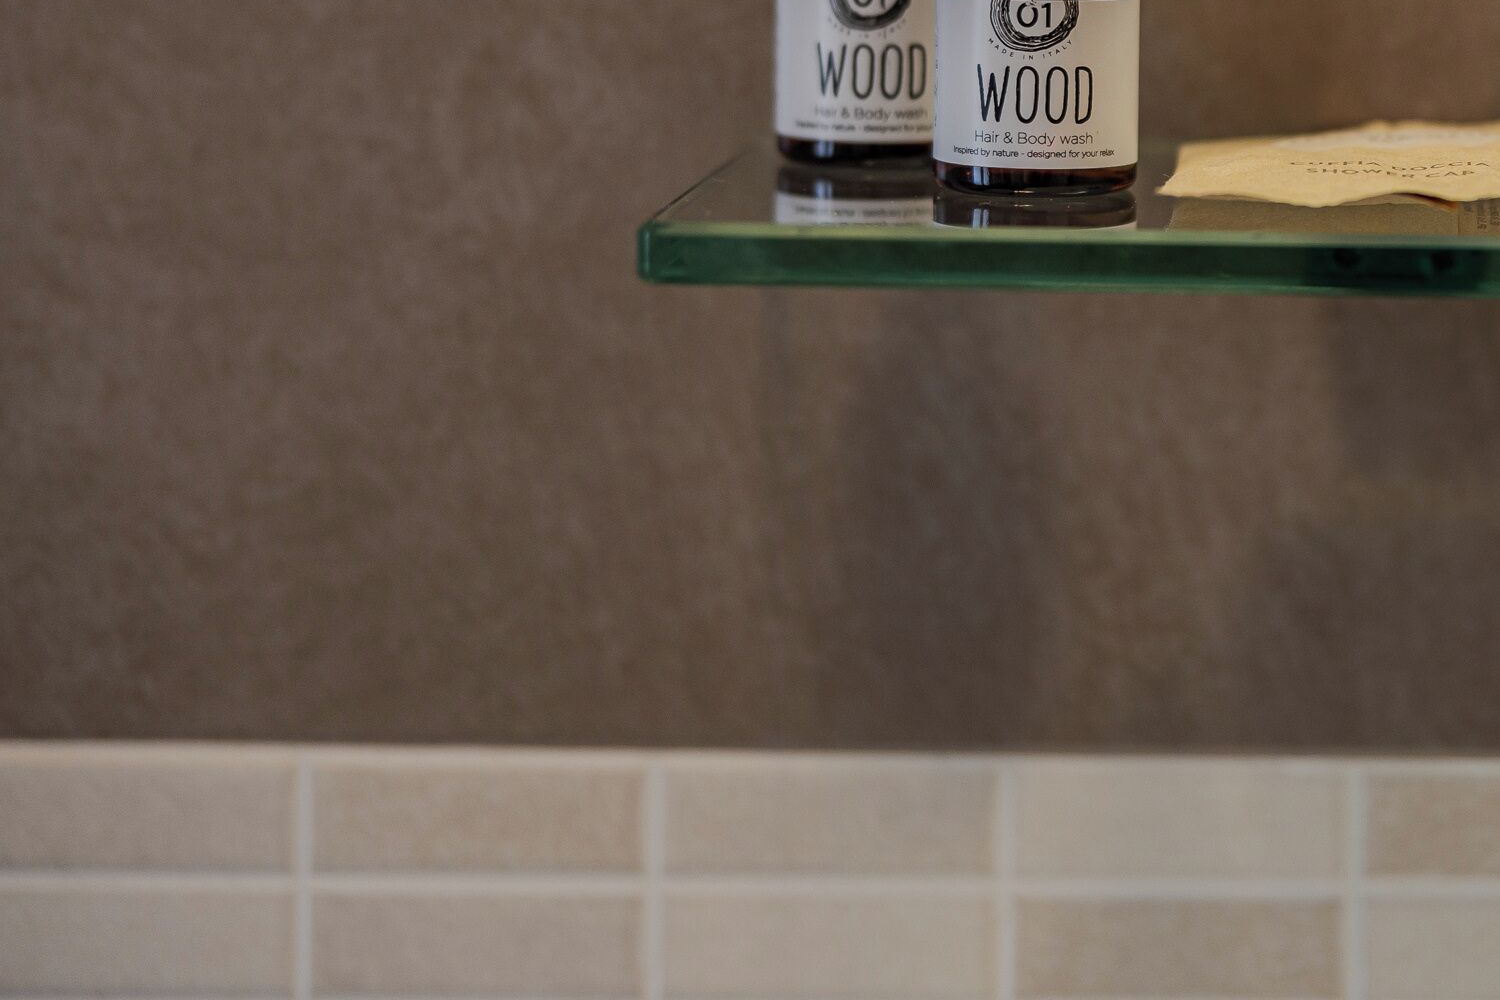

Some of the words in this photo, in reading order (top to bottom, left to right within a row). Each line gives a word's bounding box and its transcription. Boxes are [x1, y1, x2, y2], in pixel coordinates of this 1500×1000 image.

[1016, 2, 1052, 28] 01
[988, 38, 1014, 58] MADE
[1042, 40, 1072, 59] ITALY
[816, 41, 927, 100] WOOD
[977, 63, 1093, 125] WOOD
[854, 106, 891, 121] Body
[974, 130, 1000, 143] Hair
[1003, 131, 1014, 144] &
[1017, 131, 1056, 147] Body
[1060, 132, 1094, 145] wash
[953, 145, 979, 155] Inspired
[981, 148, 991, 157] by
[992, 149, 1019, 157] nature
[1026, 150, 1067, 159] designed
[1069, 150, 1080, 158] for
[1081, 150, 1099, 159] your
[1306, 168, 1415, 179] SHOWER
[1425, 170, 1475, 178] CAP
